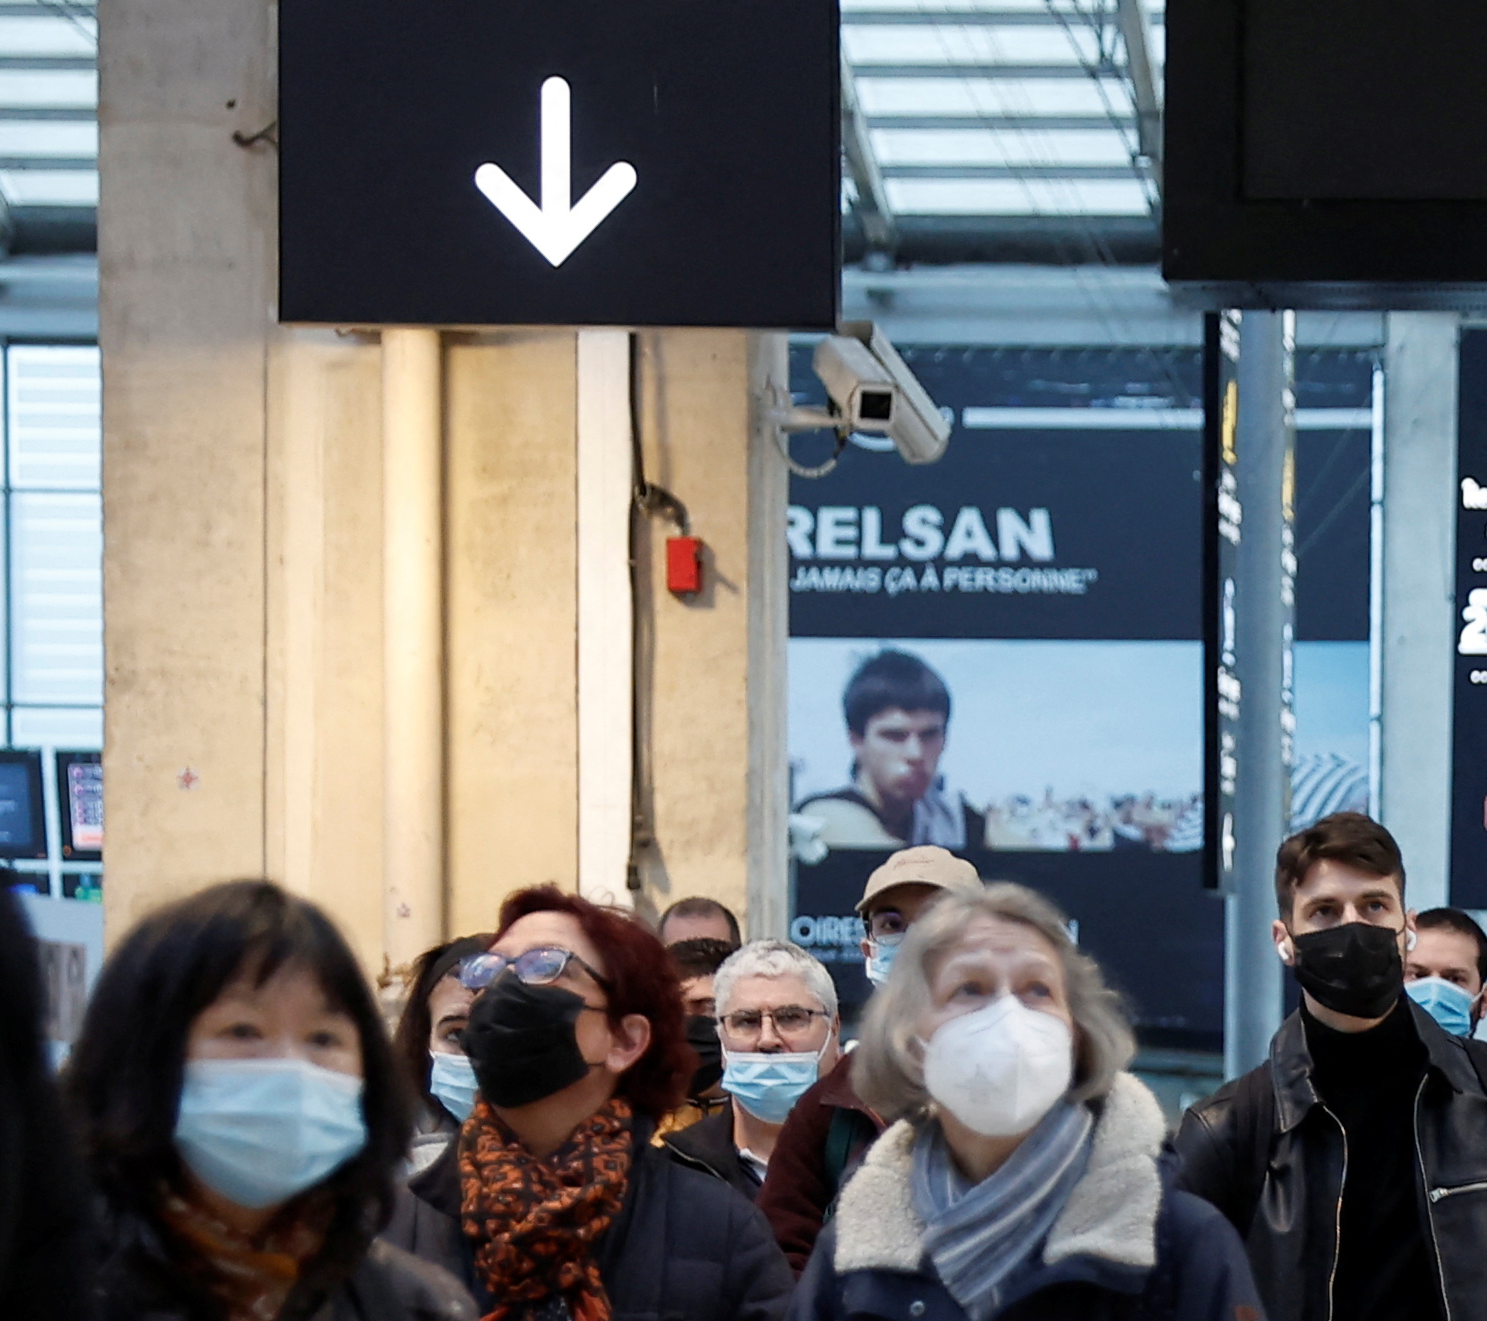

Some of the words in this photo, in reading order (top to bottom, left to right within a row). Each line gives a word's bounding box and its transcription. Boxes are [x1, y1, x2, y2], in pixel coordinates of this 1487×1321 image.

[790, 566, 882, 593] JAMAIS
[884, 566, 917, 597] ÇA
[920, 562, 941, 592] À
